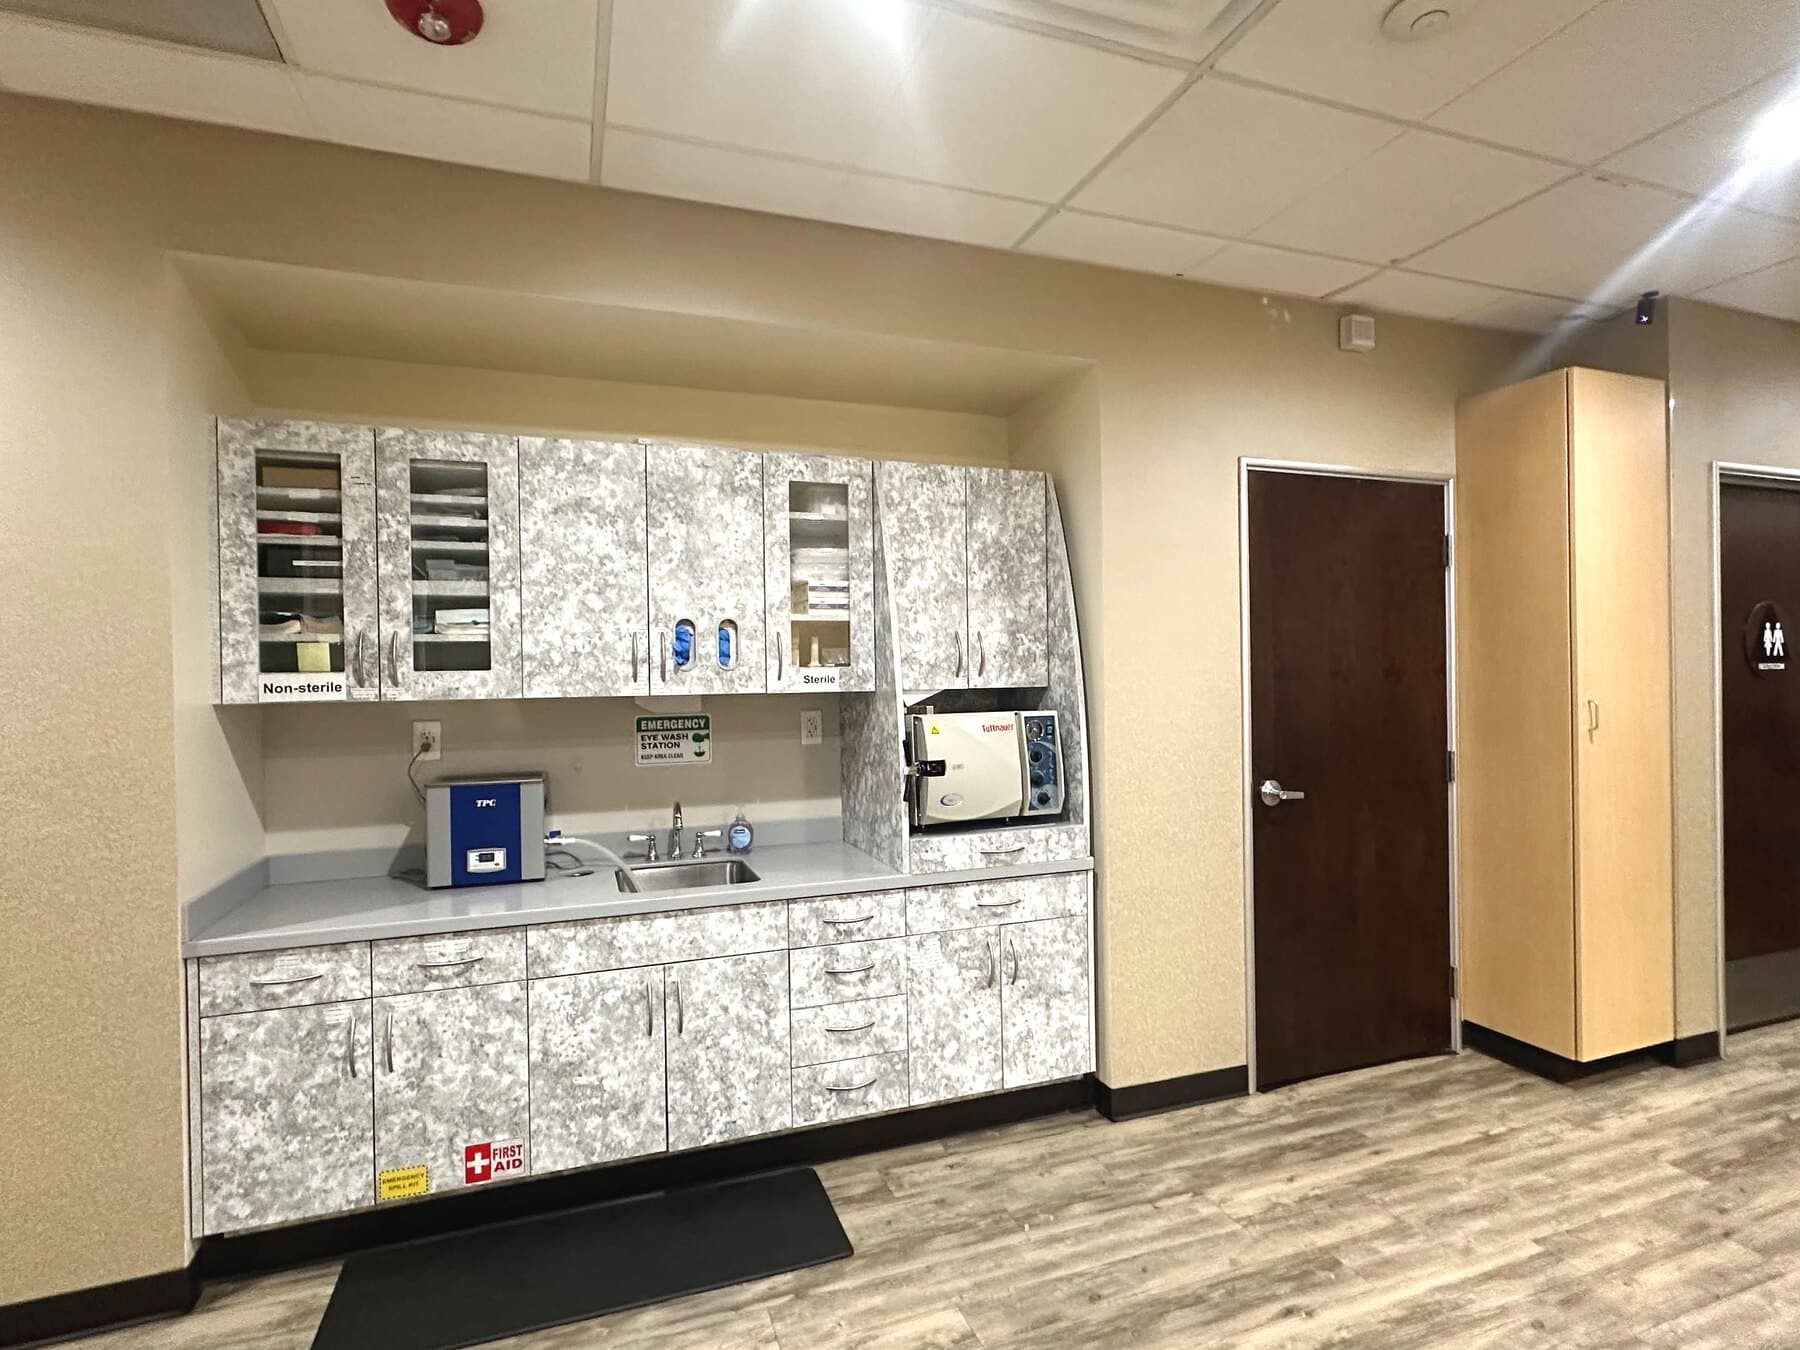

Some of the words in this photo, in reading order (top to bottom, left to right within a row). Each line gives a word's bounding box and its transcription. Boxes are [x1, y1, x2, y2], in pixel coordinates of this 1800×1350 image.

[803, 675, 836, 684] Sterile
[263, 681, 342, 694] Non-sterile
[641, 719, 705, 730] EMERGENCY
[981, 723, 1014, 733] Tuttnauer
[661, 733, 689, 741] WASH
[475, 799, 496, 807] TPC
[493, 1145, 522, 1160] FIRST
[494, 1159, 522, 1172] AID
[382, 1172, 424, 1185] EMERGENCY
